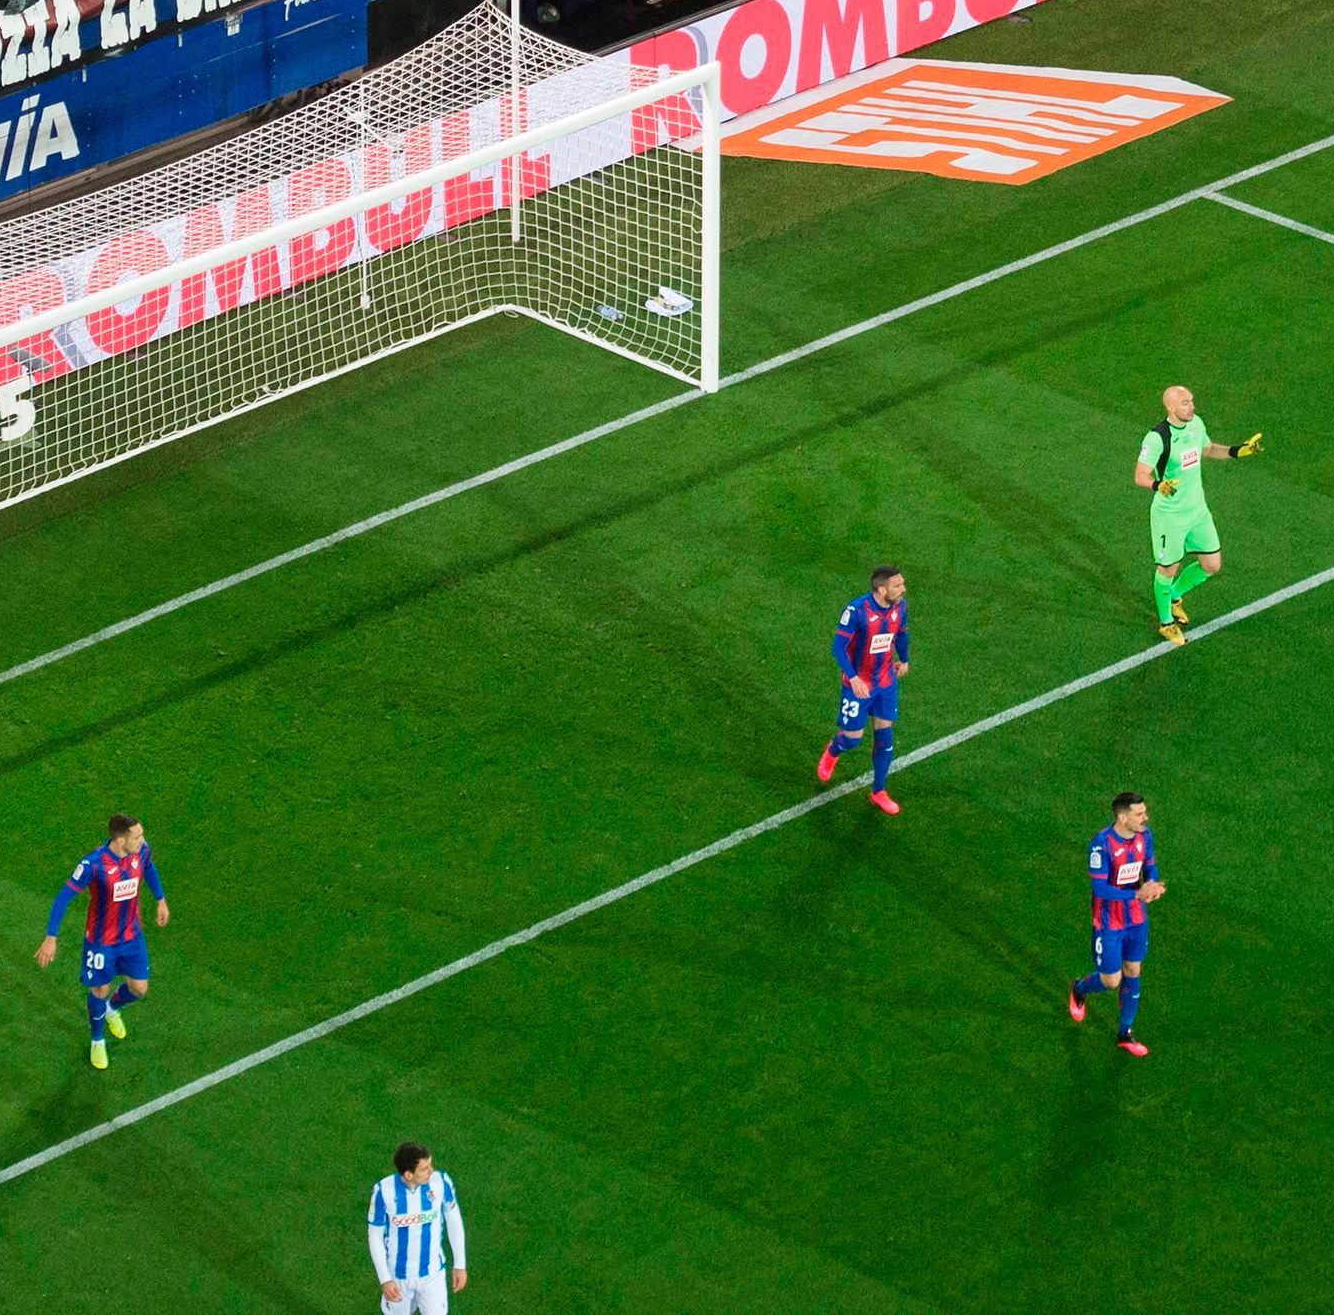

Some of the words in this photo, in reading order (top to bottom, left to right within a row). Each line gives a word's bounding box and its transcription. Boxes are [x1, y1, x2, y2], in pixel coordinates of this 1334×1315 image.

[1160, 534, 1166, 549] 1
[841, 698, 860, 719] 23
[1094, 936, 1103, 955] 6
[86, 950, 105, 971] 20
